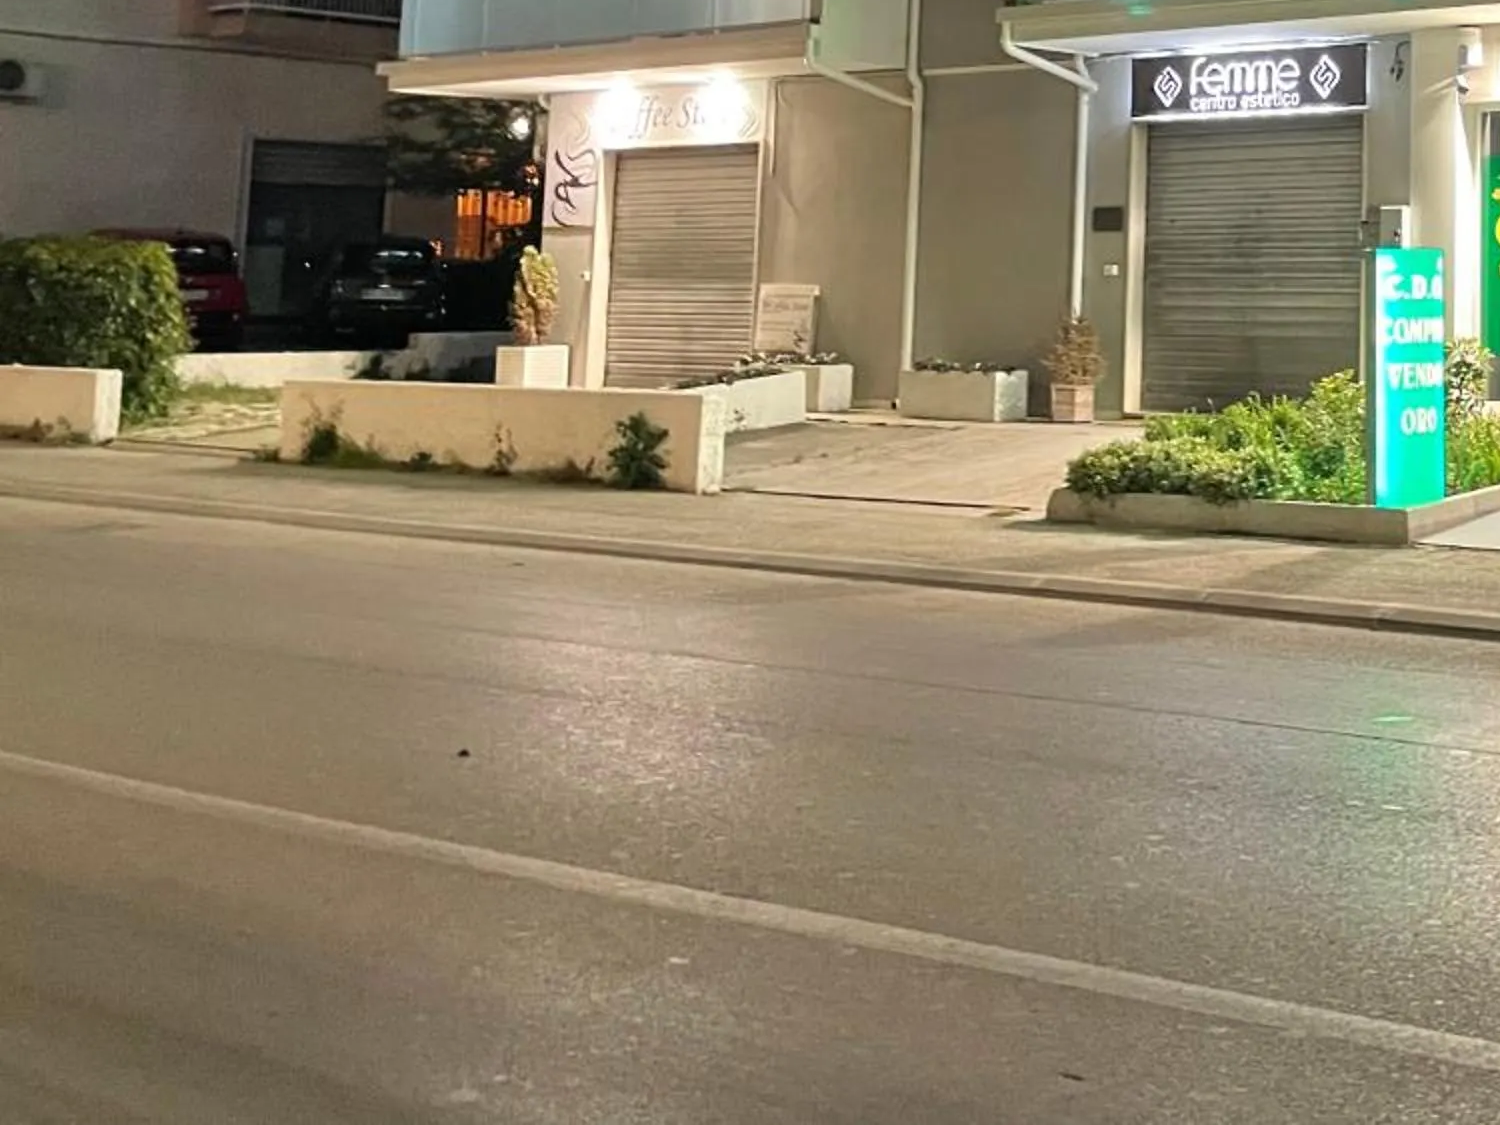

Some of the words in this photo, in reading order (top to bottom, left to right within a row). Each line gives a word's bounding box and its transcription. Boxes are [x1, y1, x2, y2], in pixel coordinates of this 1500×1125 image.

[1190, 57, 1300, 95] femme
[1190, 92, 1236, 111] centro
[1240, 91, 1300, 109] estetico
